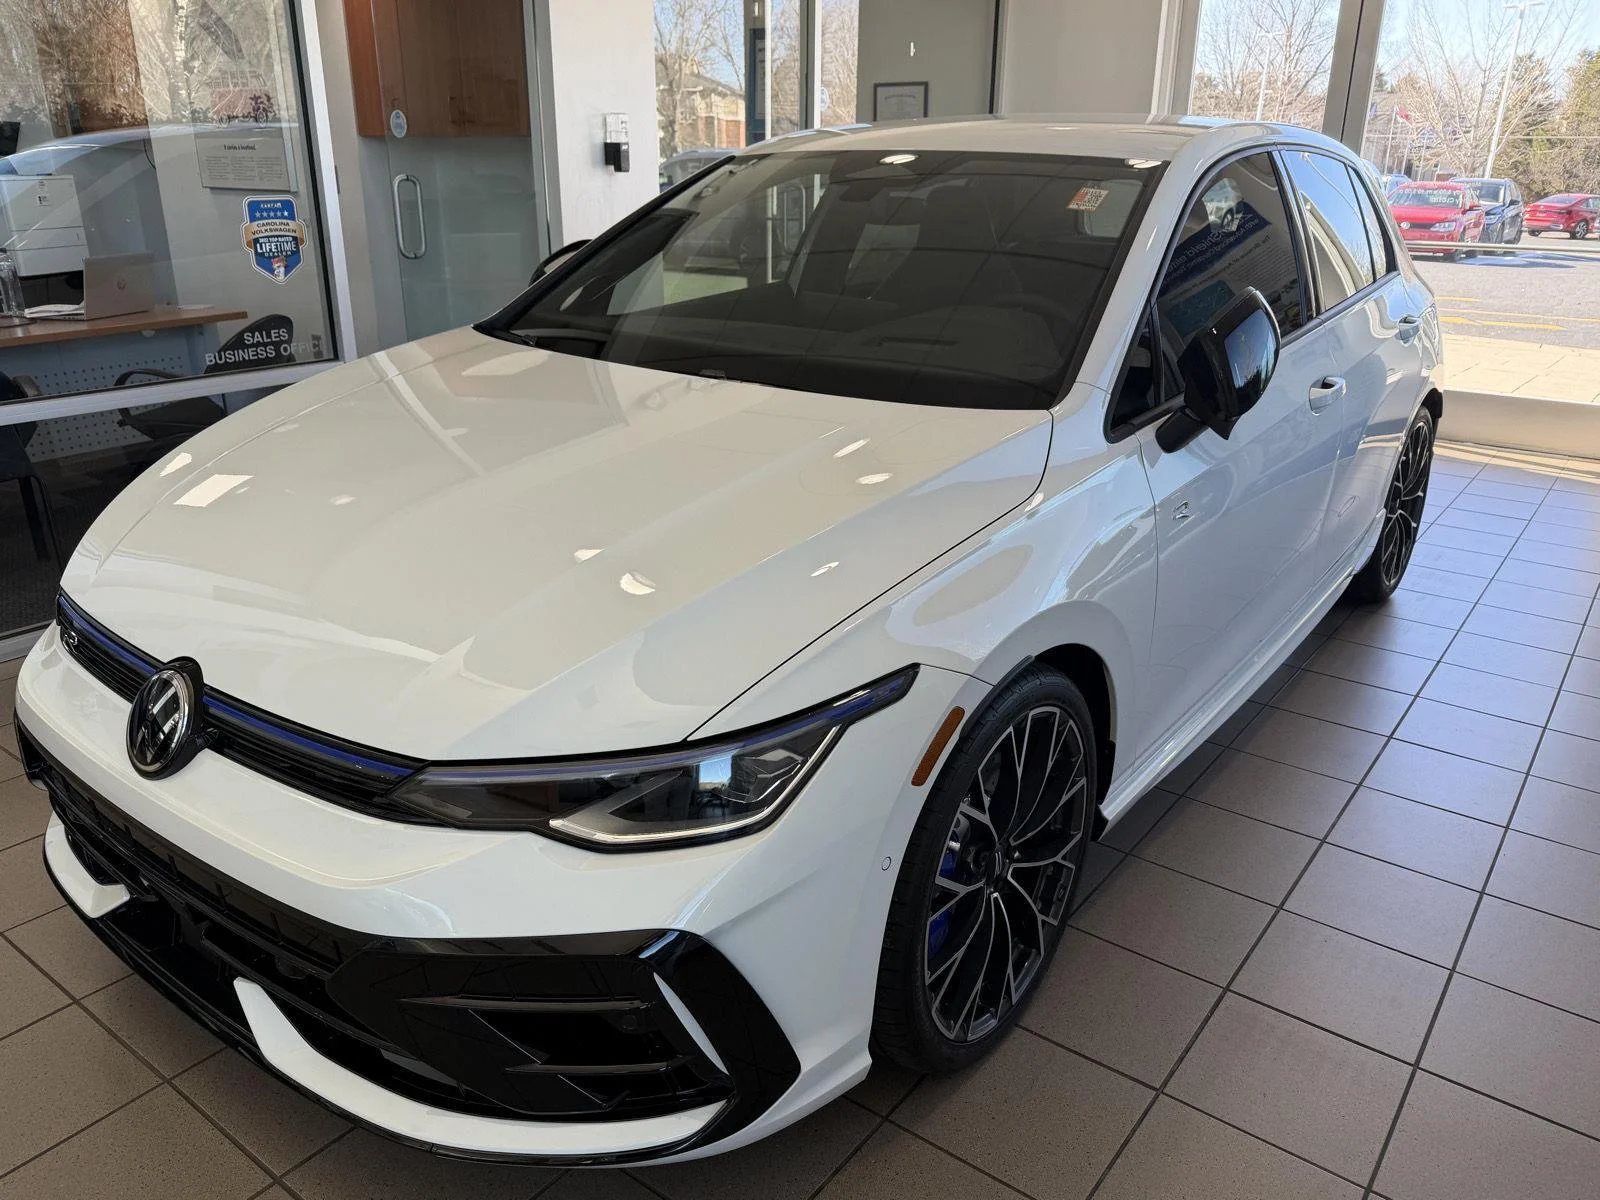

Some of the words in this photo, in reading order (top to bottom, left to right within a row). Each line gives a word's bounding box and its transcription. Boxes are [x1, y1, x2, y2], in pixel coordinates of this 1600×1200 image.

[251, 228, 297, 236] VOLKSWAGEN
[256, 241, 297, 253] LIFETIME
[243, 328, 289, 344] SALES
[205, 345, 276, 365] BUSINESS
[280, 341, 322, 356] OFFIC
